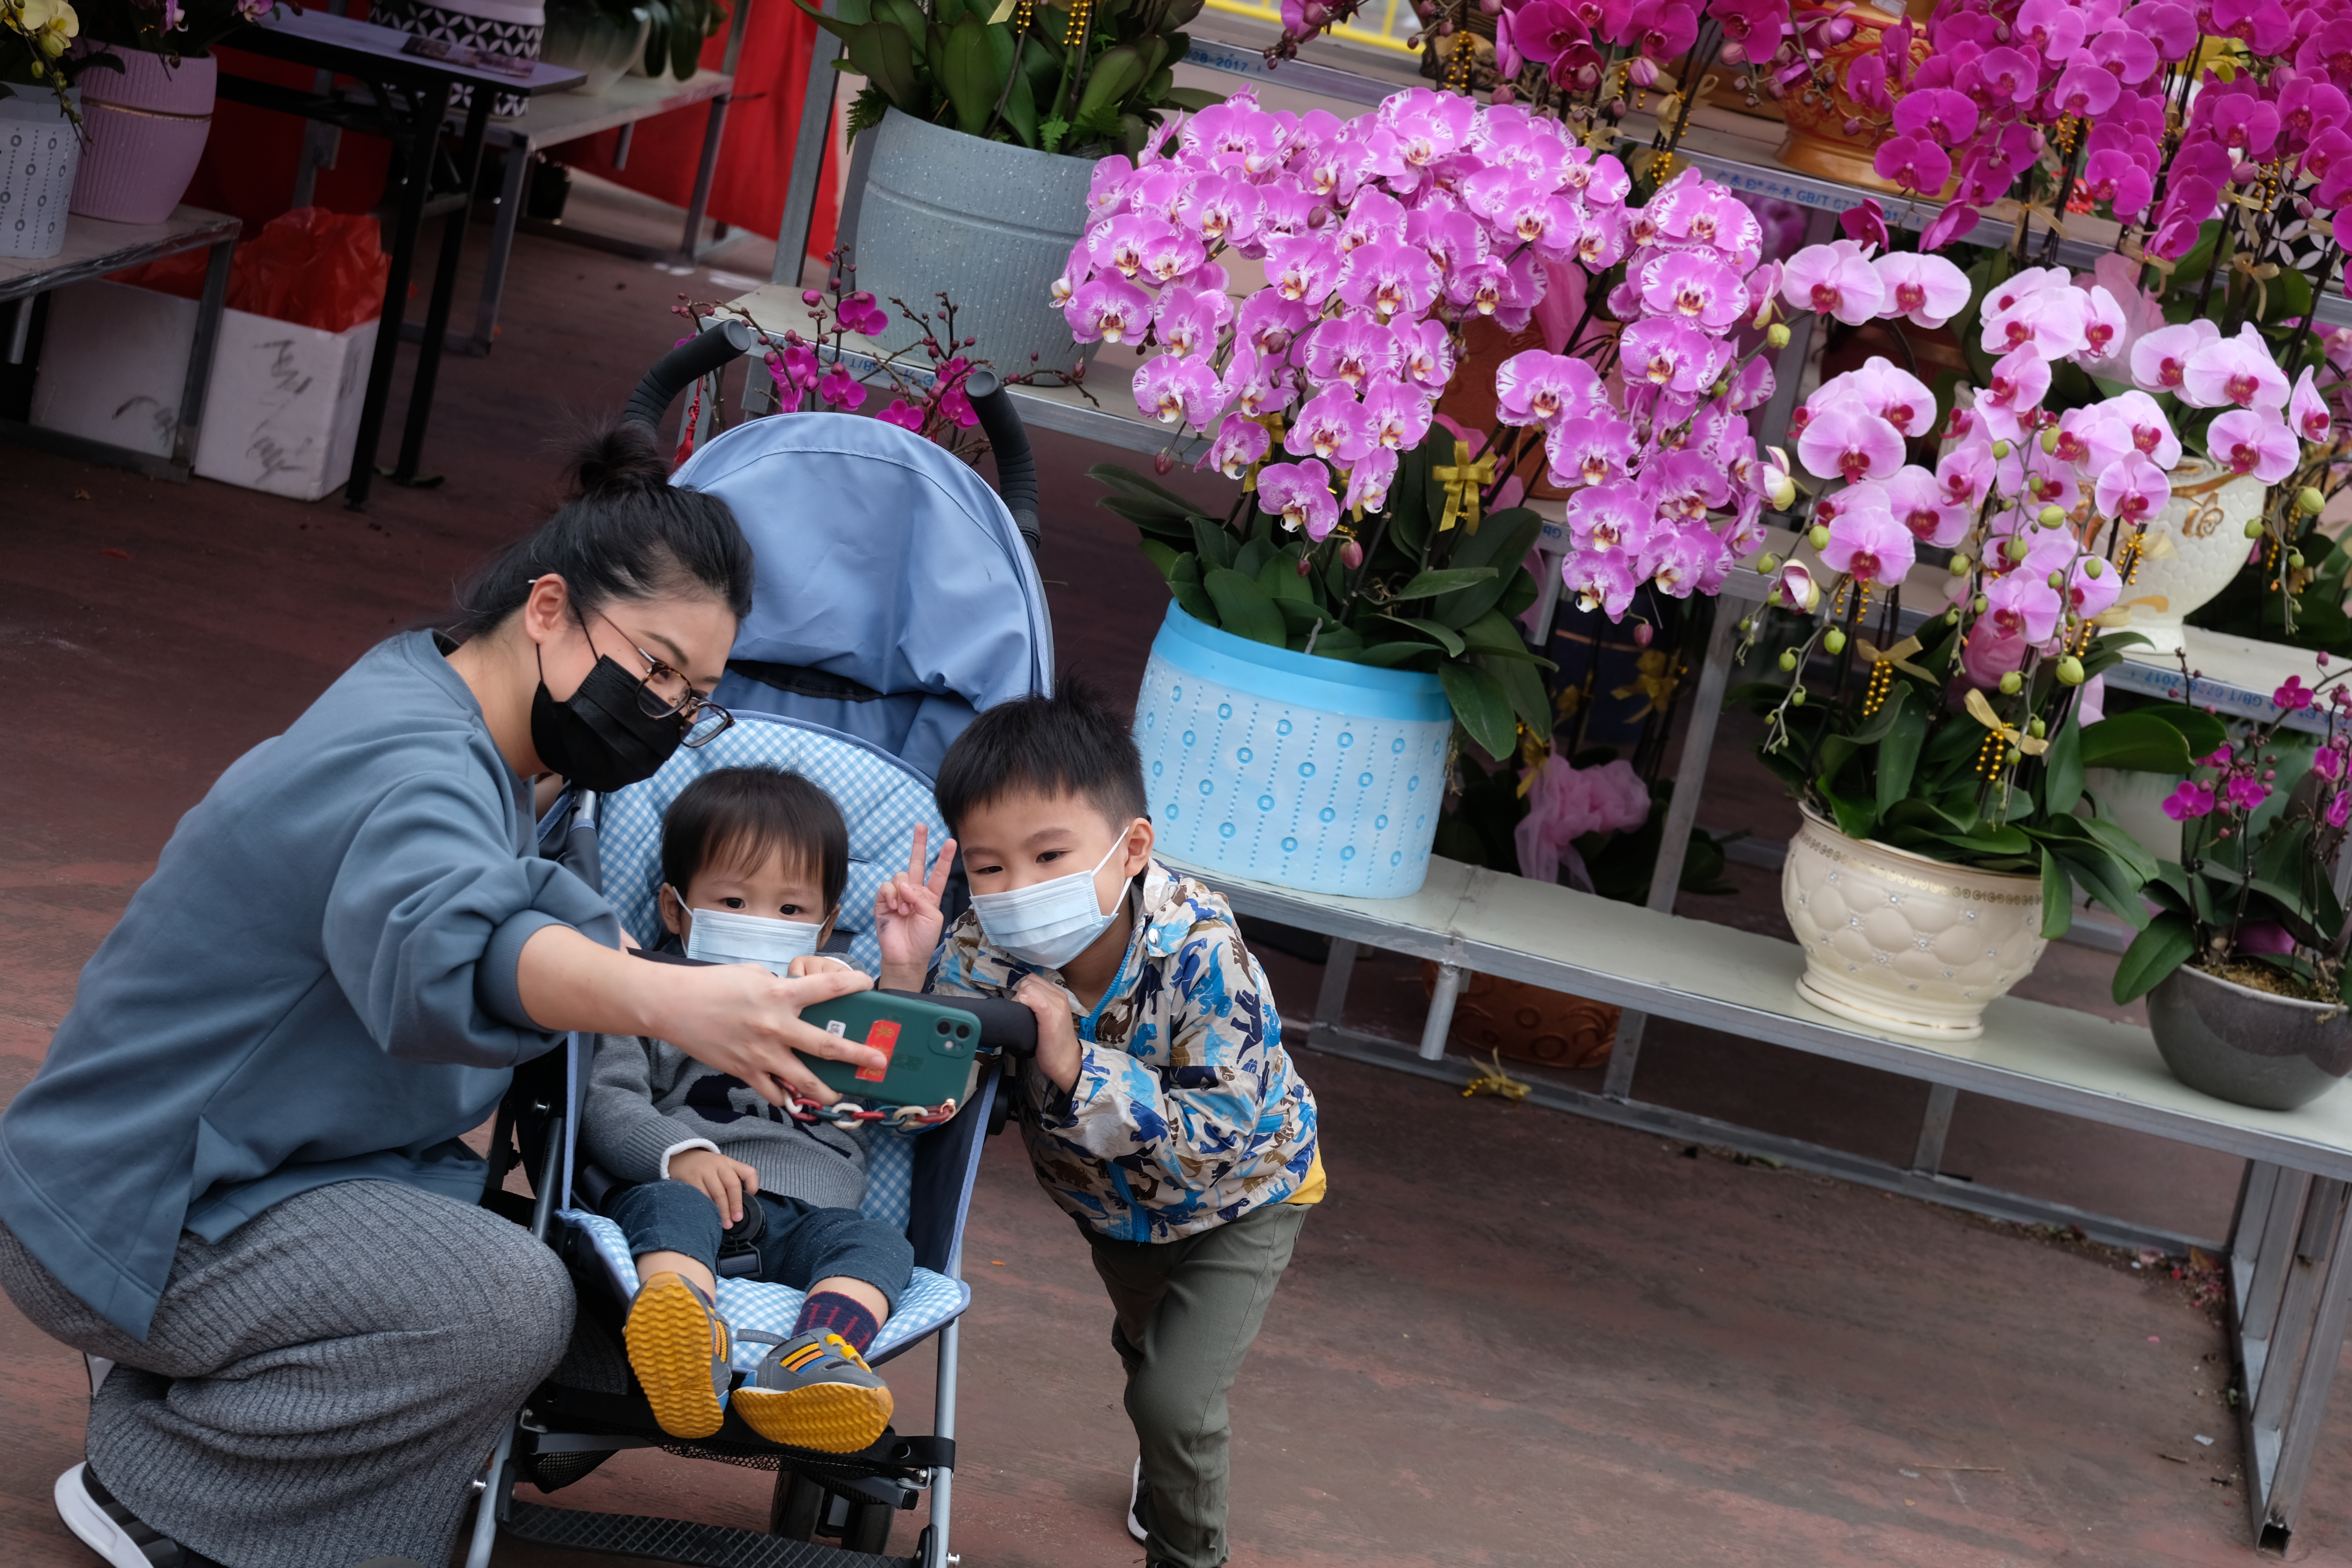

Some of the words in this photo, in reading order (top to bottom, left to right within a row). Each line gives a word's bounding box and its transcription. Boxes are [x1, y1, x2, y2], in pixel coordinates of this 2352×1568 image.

[1185, 50, 1249, 72] 728-2017
[1796, 190, 1829, 206] GB/T
[2228, 690, 2262, 707] GB/T
